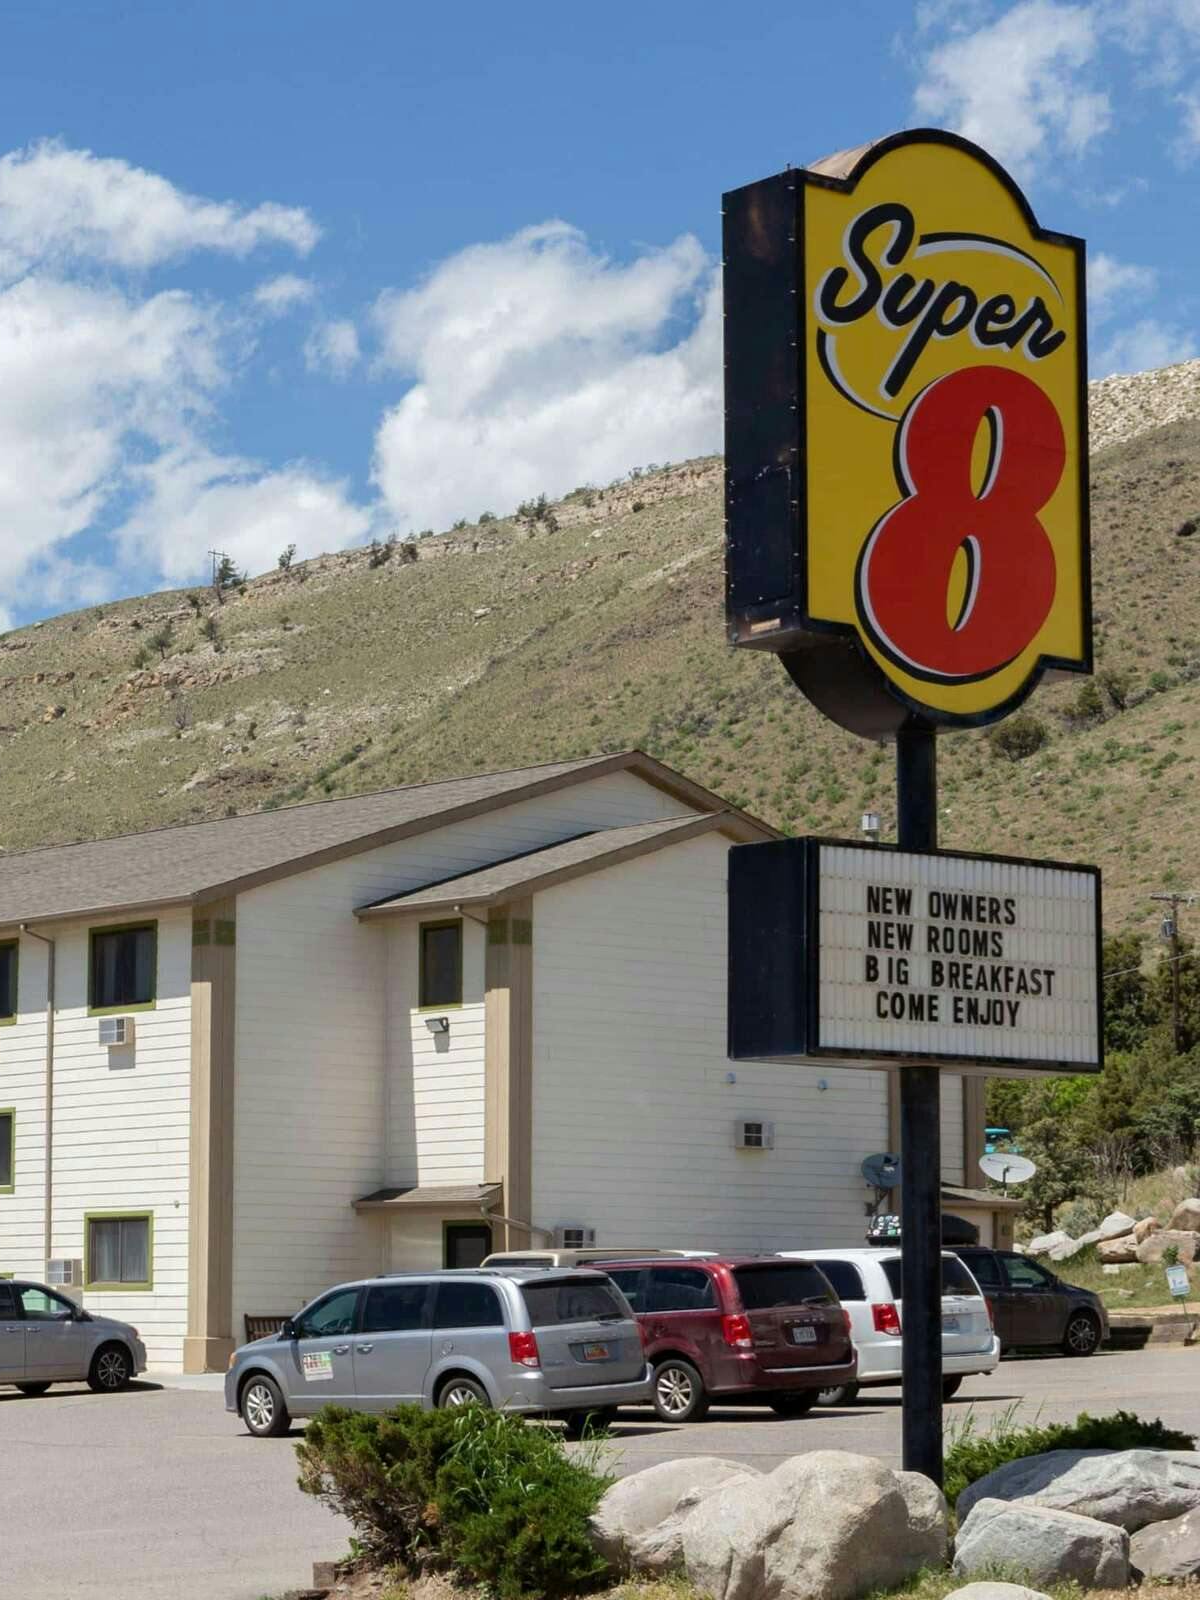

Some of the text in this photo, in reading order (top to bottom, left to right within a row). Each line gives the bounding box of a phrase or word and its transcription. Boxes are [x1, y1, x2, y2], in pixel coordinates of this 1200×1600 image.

[815, 202, 1066, 400] Super
[855, 365, 1066, 685] 8
[866, 885, 1017, 926] NEW OWNERS
[867, 920, 1003, 958] NEW ROOMS
[865, 954, 1056, 997] BIG BREAKFAST
[876, 990, 1021, 1028] COME ENJOY
